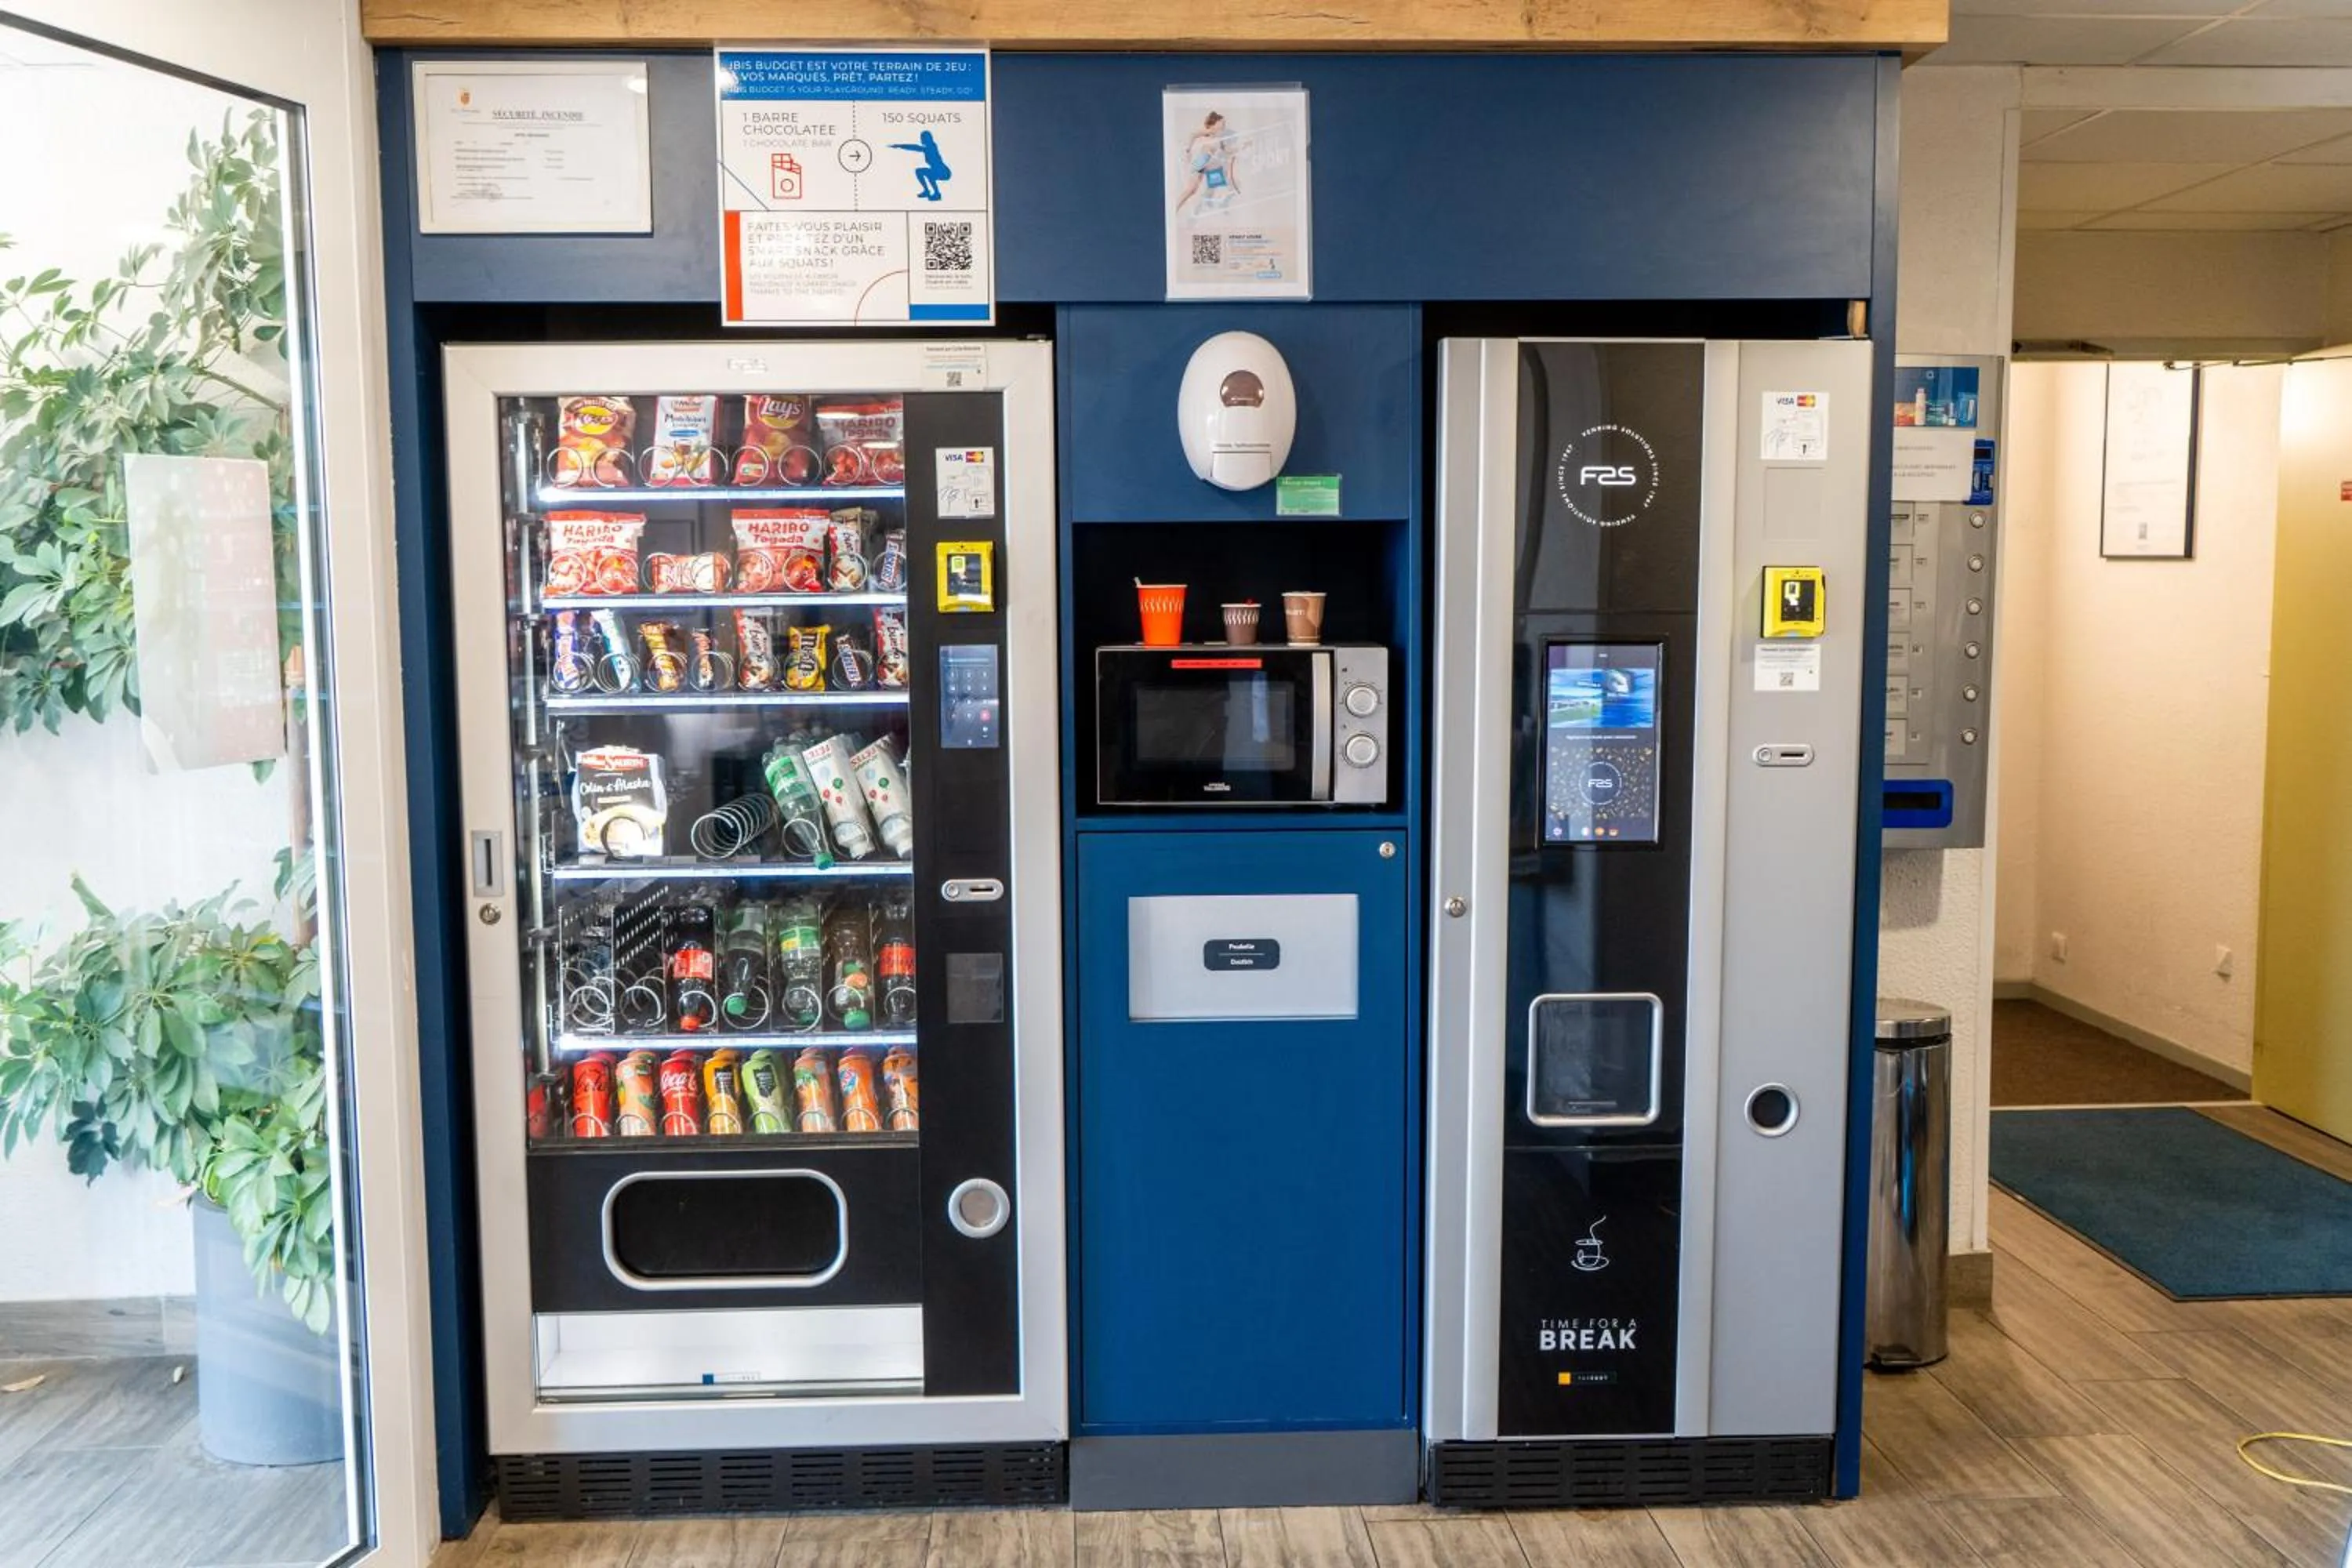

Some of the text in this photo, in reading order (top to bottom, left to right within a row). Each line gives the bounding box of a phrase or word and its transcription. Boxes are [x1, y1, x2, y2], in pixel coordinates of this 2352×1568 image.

[756, 60, 804, 71] BUDGET
[808, 61, 827, 71] EST
[831, 61, 869, 71] VOTRE
[871, 62, 922, 71] TERRAIN
[926, 63, 942, 71] DE
[742, 72, 766, 82] VOS
[750, 86, 786, 95] BUDGET
[799, 86, 822, 95] YOUR
[743, 112, 799, 123] 1 BARRE
[881, 112, 963, 124] 150 SQUATS
[811, 139, 832, 147] BAR
[833, 222, 883, 232] PLAISIR
[748, 234, 762, 244] ET
[833, 234, 864, 244] D'UN
[795, 246, 838, 256] SNACK
[841, 245, 886, 256] GRÂCE
[833, 416, 895, 428] HARIBO
[945, 453, 964, 463] VISA
[747, 521, 810, 534] HARIBO
[1541, 1318, 1637, 1330] TIME FOR A
[1539, 1329, 1637, 1351] BREAK
